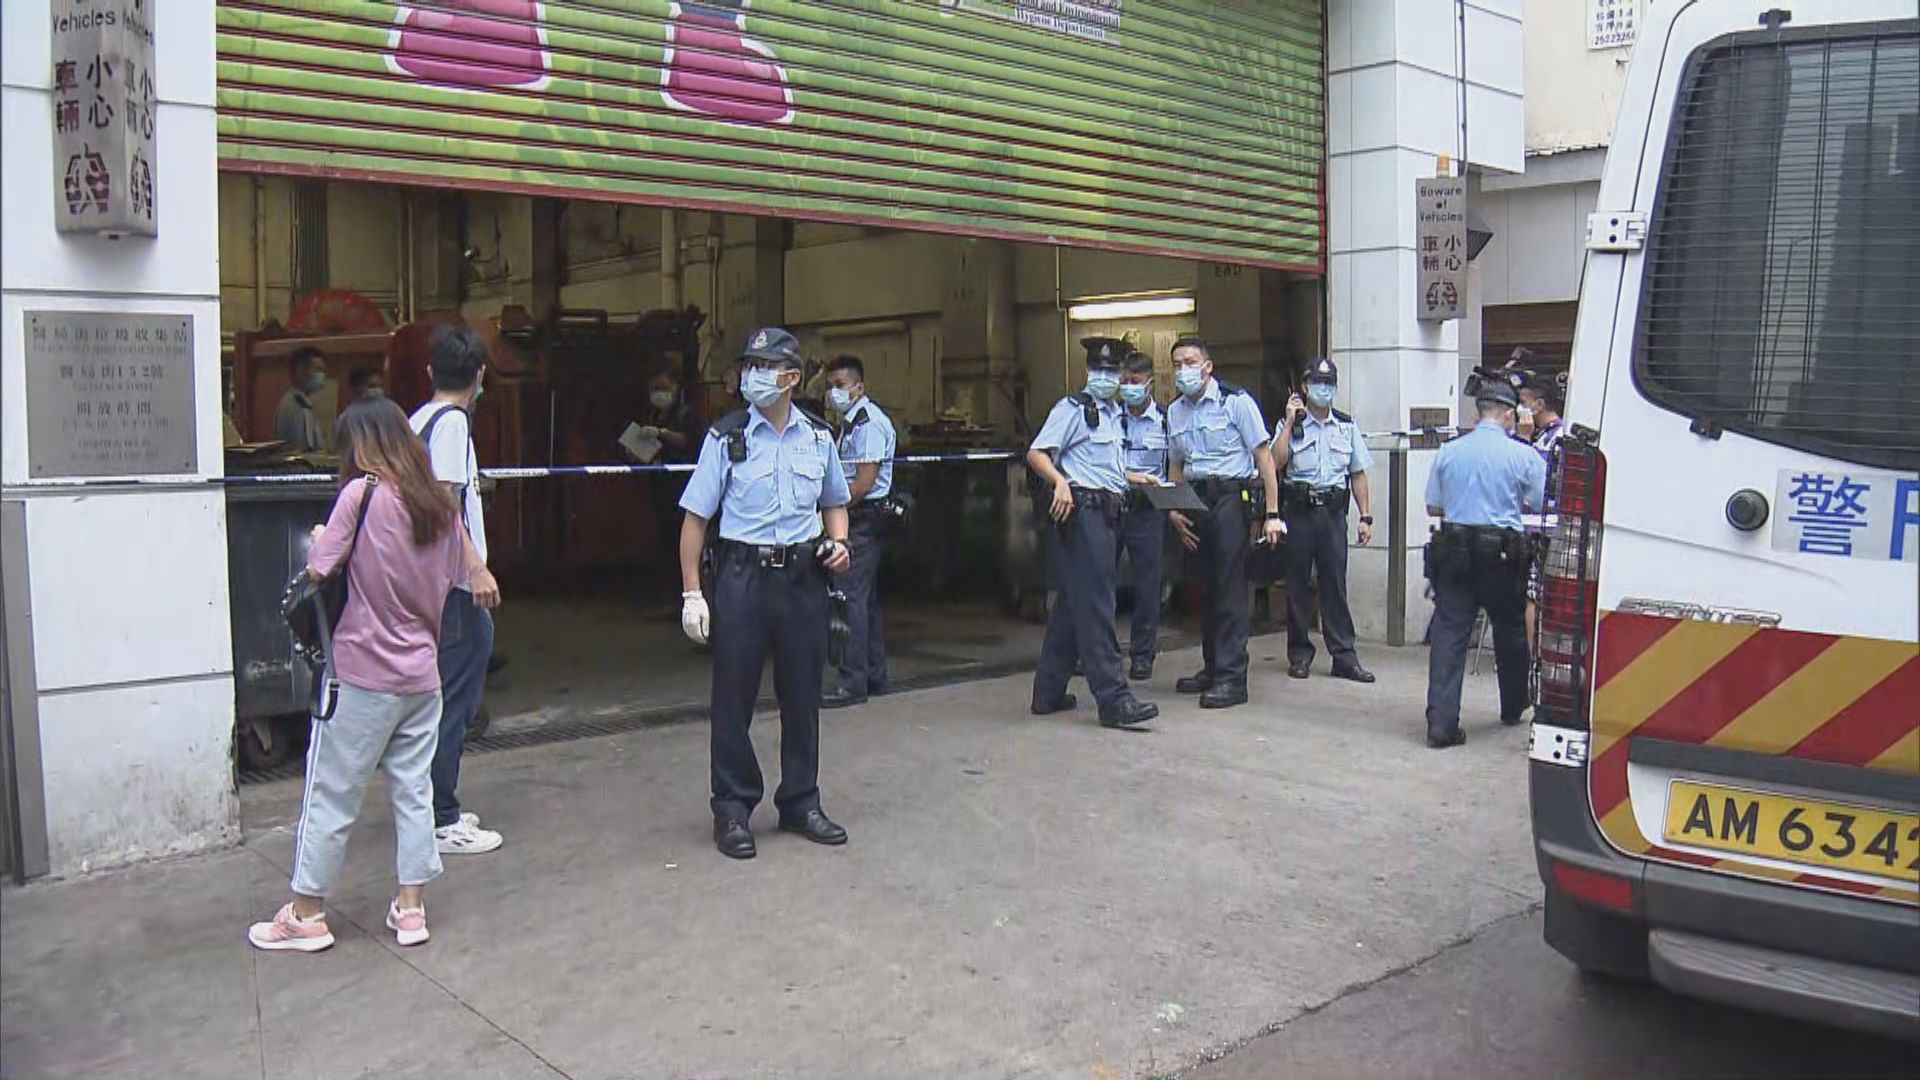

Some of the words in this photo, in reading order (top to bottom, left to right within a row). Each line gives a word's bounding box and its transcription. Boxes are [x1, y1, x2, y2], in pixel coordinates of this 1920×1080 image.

[52, 9, 116, 34] Vehicles
[1054, 16, 1104, 40] Department
[55, 58, 80, 134] 車輛
[86, 53, 114, 130] 小心
[1419, 211, 1463, 223] Vehicles
[1421, 235, 1440, 273] 車輛
[1443, 234, 1463, 272] 小心
[1788, 473, 1871, 556] 警
[1681, 793, 1760, 846] AM
